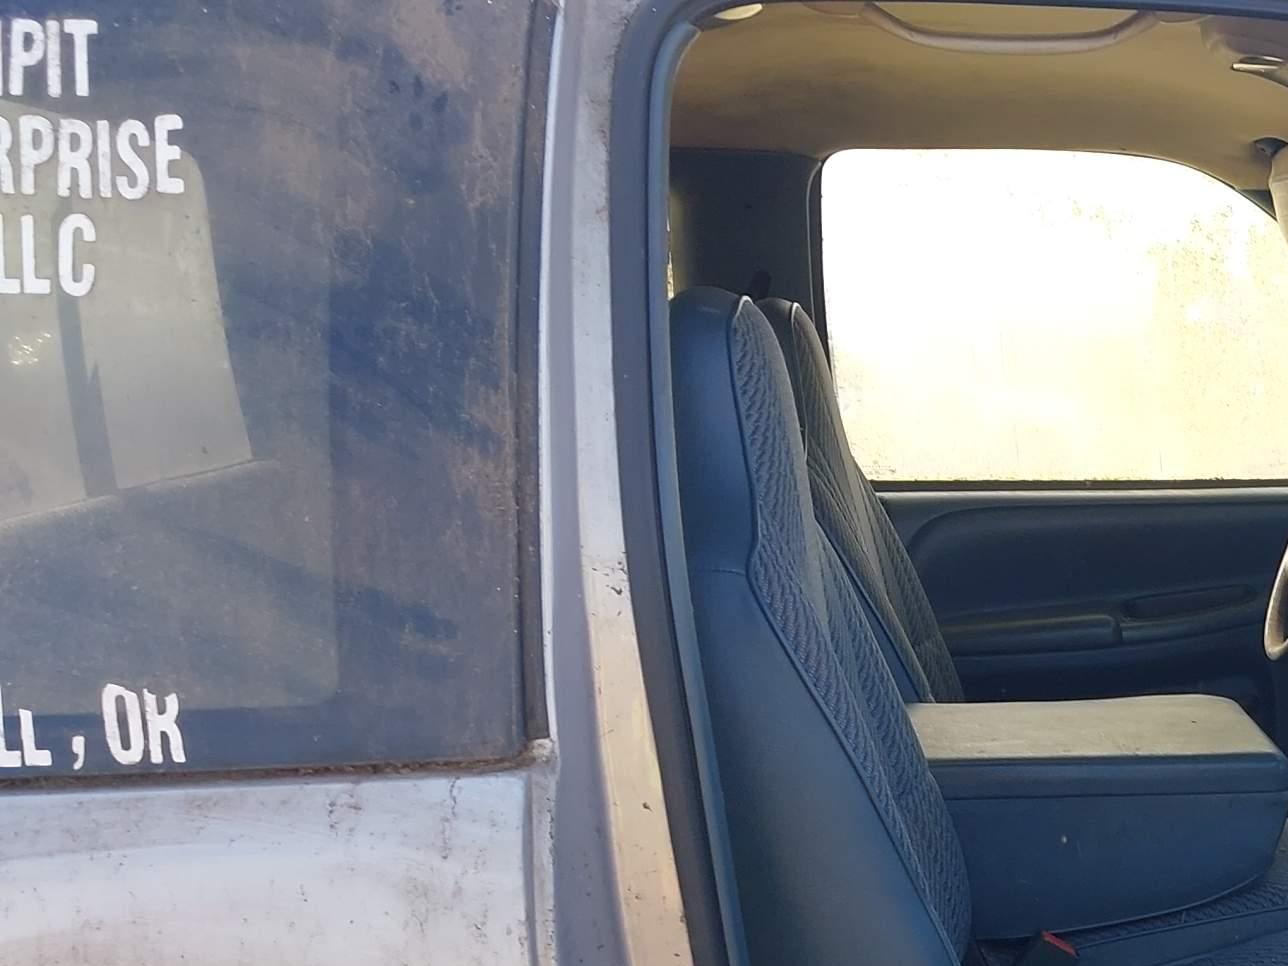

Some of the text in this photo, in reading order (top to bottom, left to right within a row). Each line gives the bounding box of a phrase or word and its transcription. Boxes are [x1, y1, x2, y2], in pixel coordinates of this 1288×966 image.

[0, 18, 98, 97] PIT
[0, 213, 96, 296] LLC
[101, 683, 186, 765] OK
